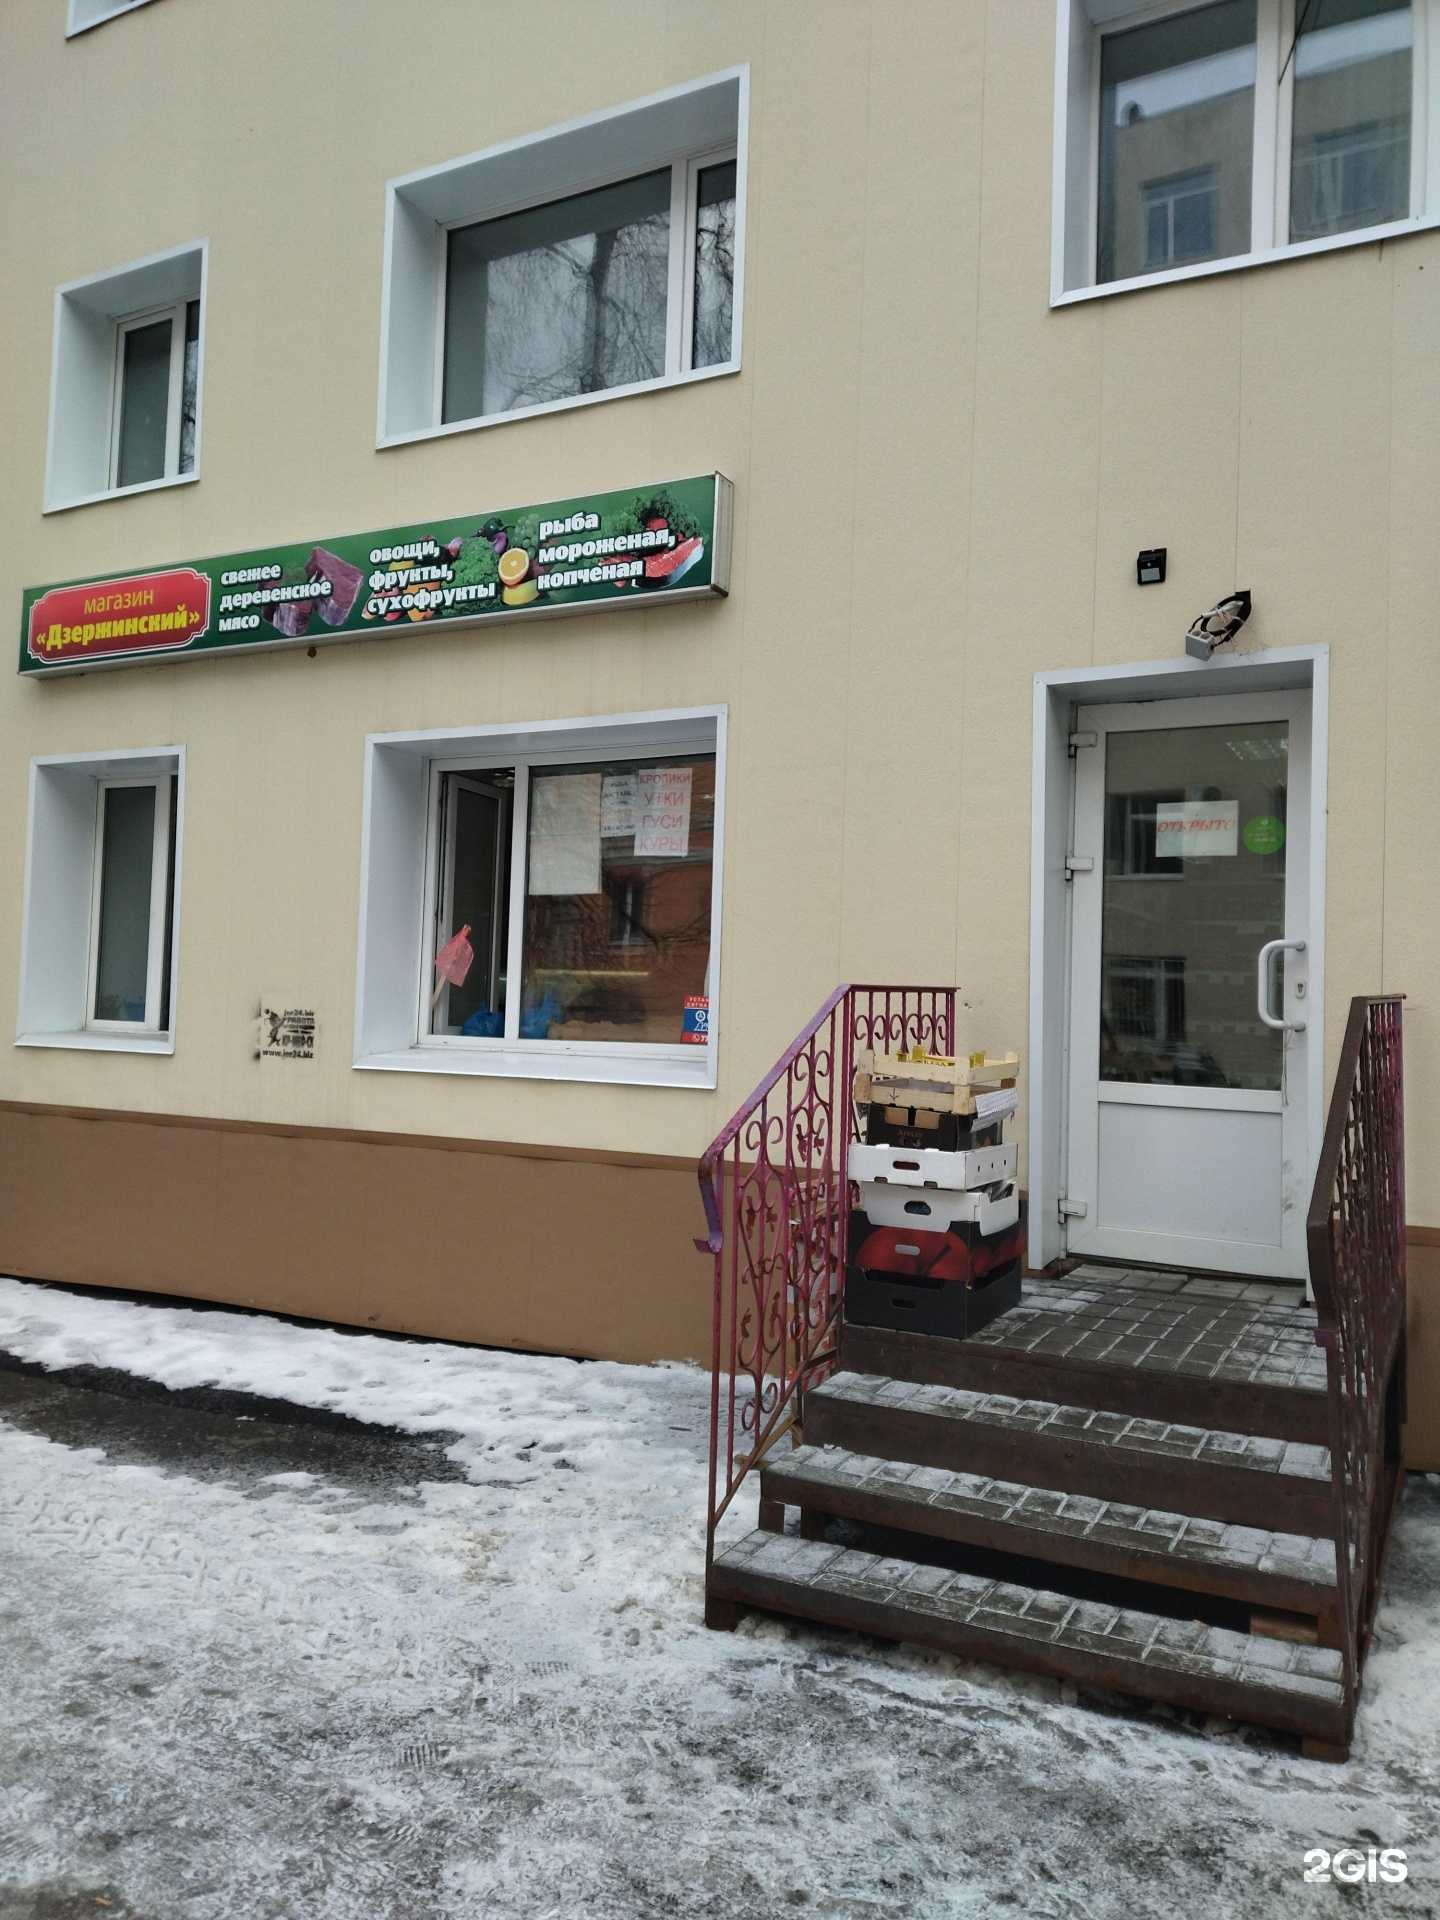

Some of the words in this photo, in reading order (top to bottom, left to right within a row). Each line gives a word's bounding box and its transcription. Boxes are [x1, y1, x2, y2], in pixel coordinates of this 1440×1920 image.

[539, 511, 599, 542] рыба
[369, 538, 440, 563] овощи,
[537, 527, 676, 569] мороженая,
[220, 564, 282, 586] свежее
[368, 562, 453, 591] фрукты,
[536, 560, 644, 590] копченая
[84, 588, 154, 616] магазин
[219, 579, 332, 612] деревенское
[367, 581, 496, 616] сухофрукты
[36, 605, 201, 650] «Дзержинский»
[218, 615, 261, 634] мясо
[639, 773, 691, 785] КРОЛИКИ
[643, 791, 685, 805] УТКИ
[642, 814, 684, 830] ГУСИ
[640, 837, 684, 851] КУРЫ
